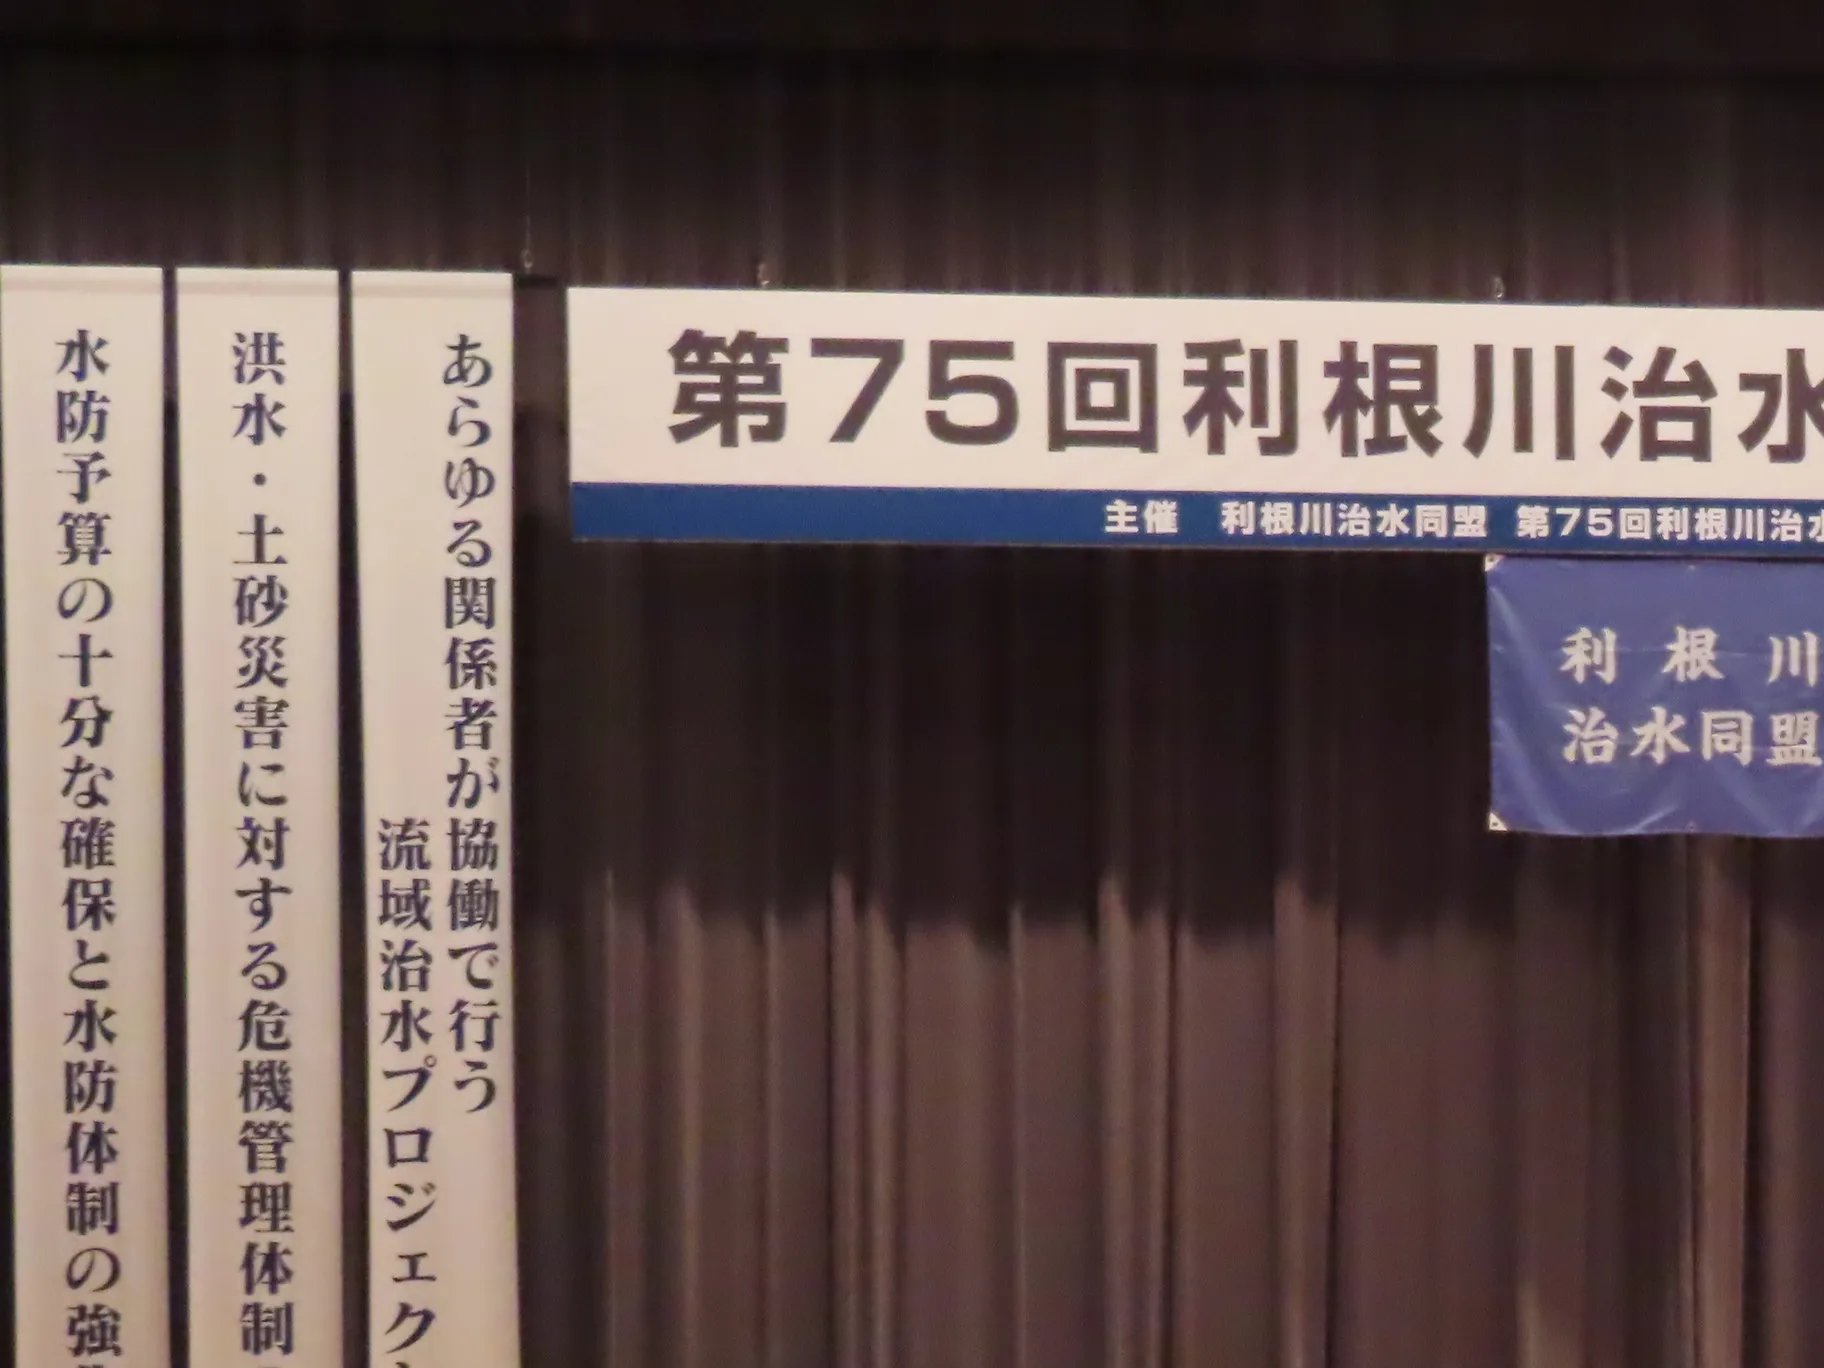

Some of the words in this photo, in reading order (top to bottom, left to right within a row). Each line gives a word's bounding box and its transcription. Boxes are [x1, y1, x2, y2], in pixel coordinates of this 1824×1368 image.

[1104, 498, 1179, 534] 主催
[1220, 500, 1488, 538] 利根川治水同盟
[442, 333, 501, 1113] あらゆる関係者が協働で行う
[1562, 705, 1824, 767] 治水同盟
